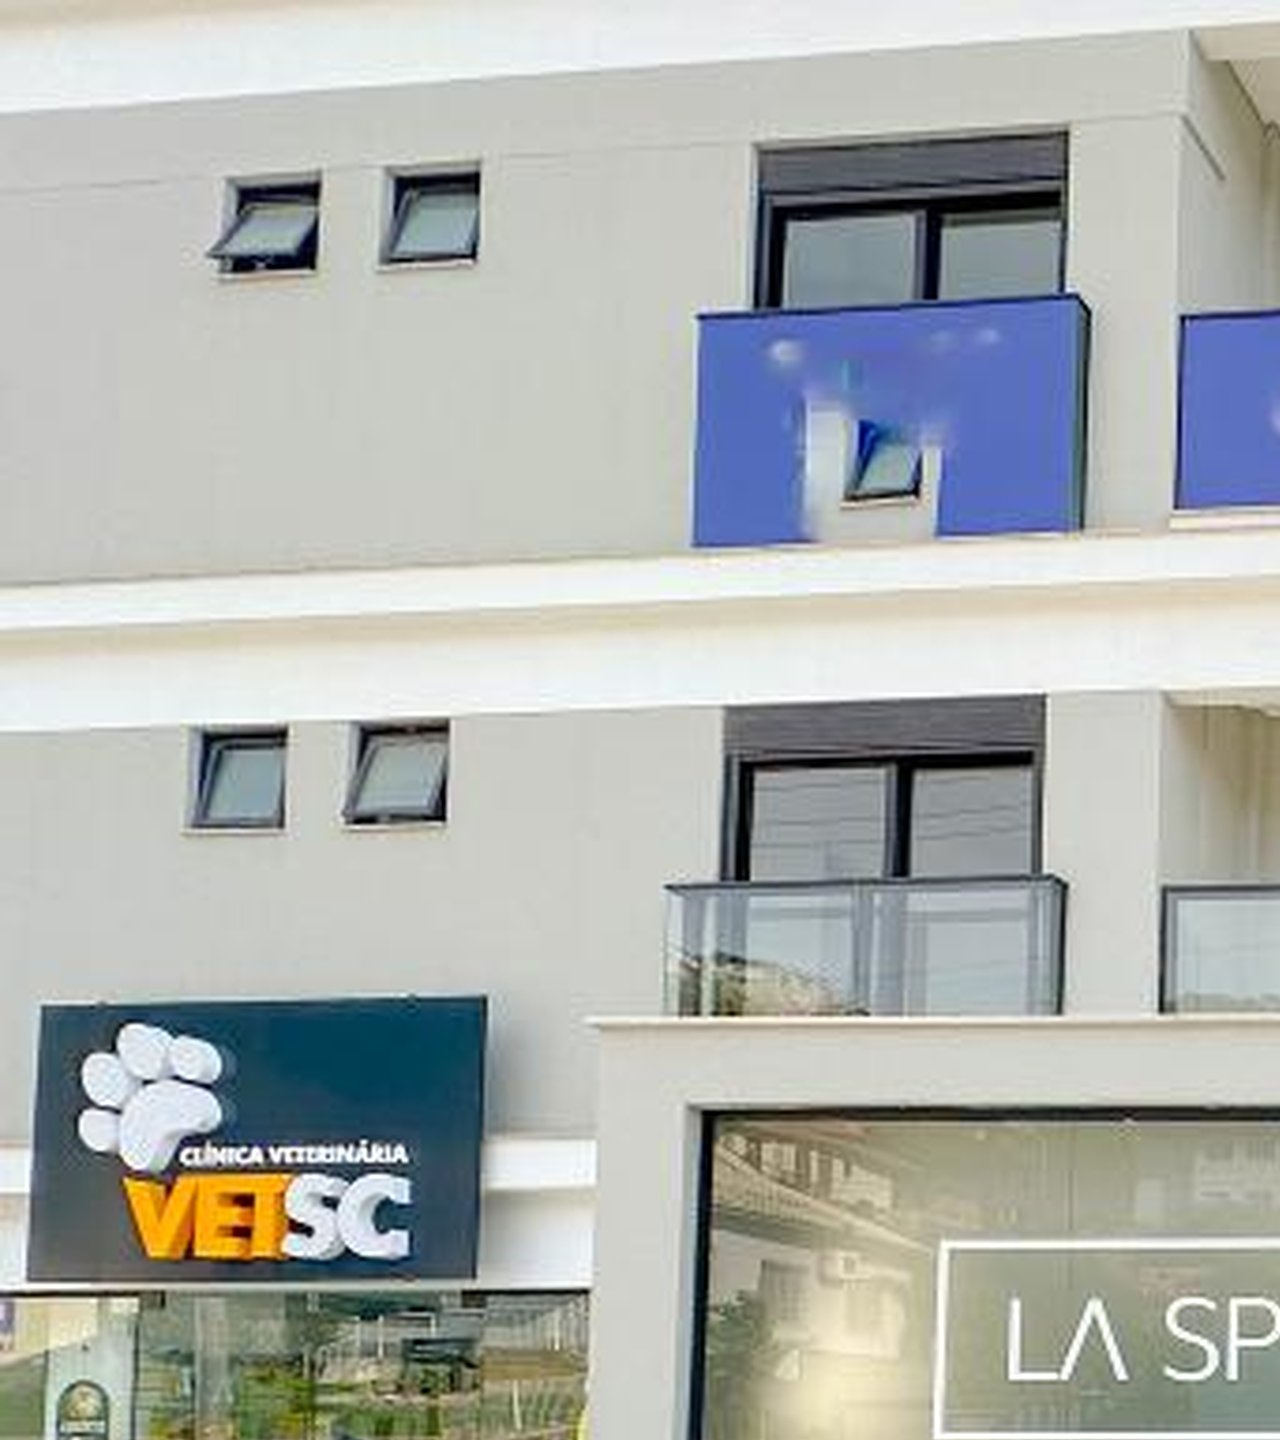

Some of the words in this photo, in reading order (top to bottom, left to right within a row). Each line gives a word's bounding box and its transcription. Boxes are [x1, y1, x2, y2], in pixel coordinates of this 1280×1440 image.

[179, 1141, 263, 1167] CLÍNICA
[268, 1139, 409, 1165] VETERINÁRIA
[1007, 1297, 1130, 1382] LA
